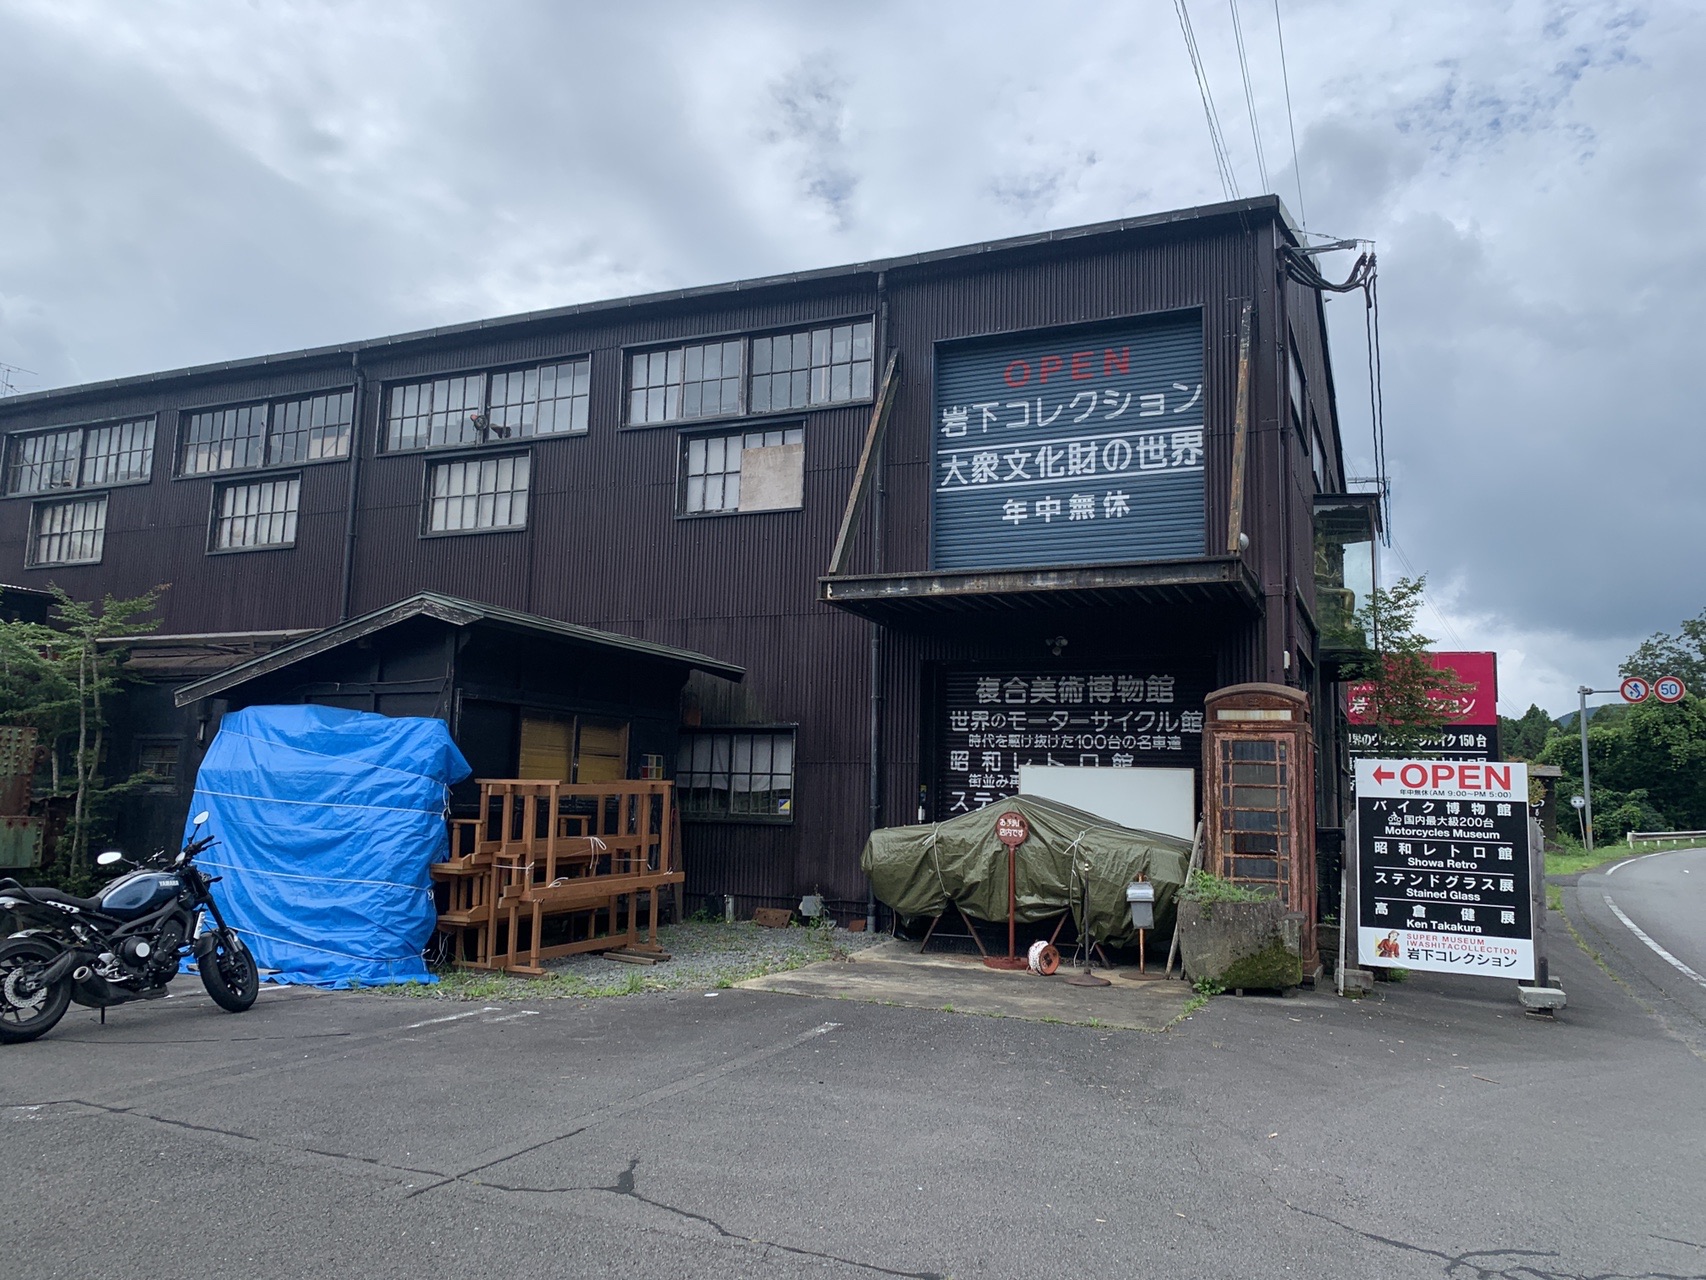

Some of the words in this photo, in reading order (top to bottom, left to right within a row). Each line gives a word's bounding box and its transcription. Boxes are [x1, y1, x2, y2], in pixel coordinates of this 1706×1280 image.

[1003, 346, 1130, 388] OPEN
[940, 382, 1202, 438] 岩下コレクション
[940, 430, 1204, 487] 大衆文化財の世界
[1001, 490, 1130, 525] 年中無休
[975, 674, 1175, 704] 複合美術博物館
[1661, 684, 1677, 695] 50
[949, 710, 1204, 733] 世界のモーターサイクル館
[968, 734, 1182, 751] 時代を駆け抜けた100台の名車達
[1400, 763, 1512, 791] OPEN
[1372, 801, 1512, 817] バイク博物館
[1404, 815, 1494, 828] 国内最大級200台
[1385, 826, 1450, 838] Motorcycles
[1453, 829, 1500, 840] Museum
[1374, 841, 1513, 861] 昭和レトロ館
[1407, 857, 1444, 868] Showa
[1448, 859, 1478, 870] Retro
[1375, 872, 1514, 892] ステンドグラス展
[1406, 888, 1447, 899] Stained
[1449, 890, 1481, 901] Glass
[1406, 918, 1428, 929] Ken
[1430, 921, 1482, 933] Takakura
[1406, 933, 1438, 941] SUPER
[1442, 936, 1485, 945] MUSEUM
[1407, 947, 1517, 968] 岩下コレクション
